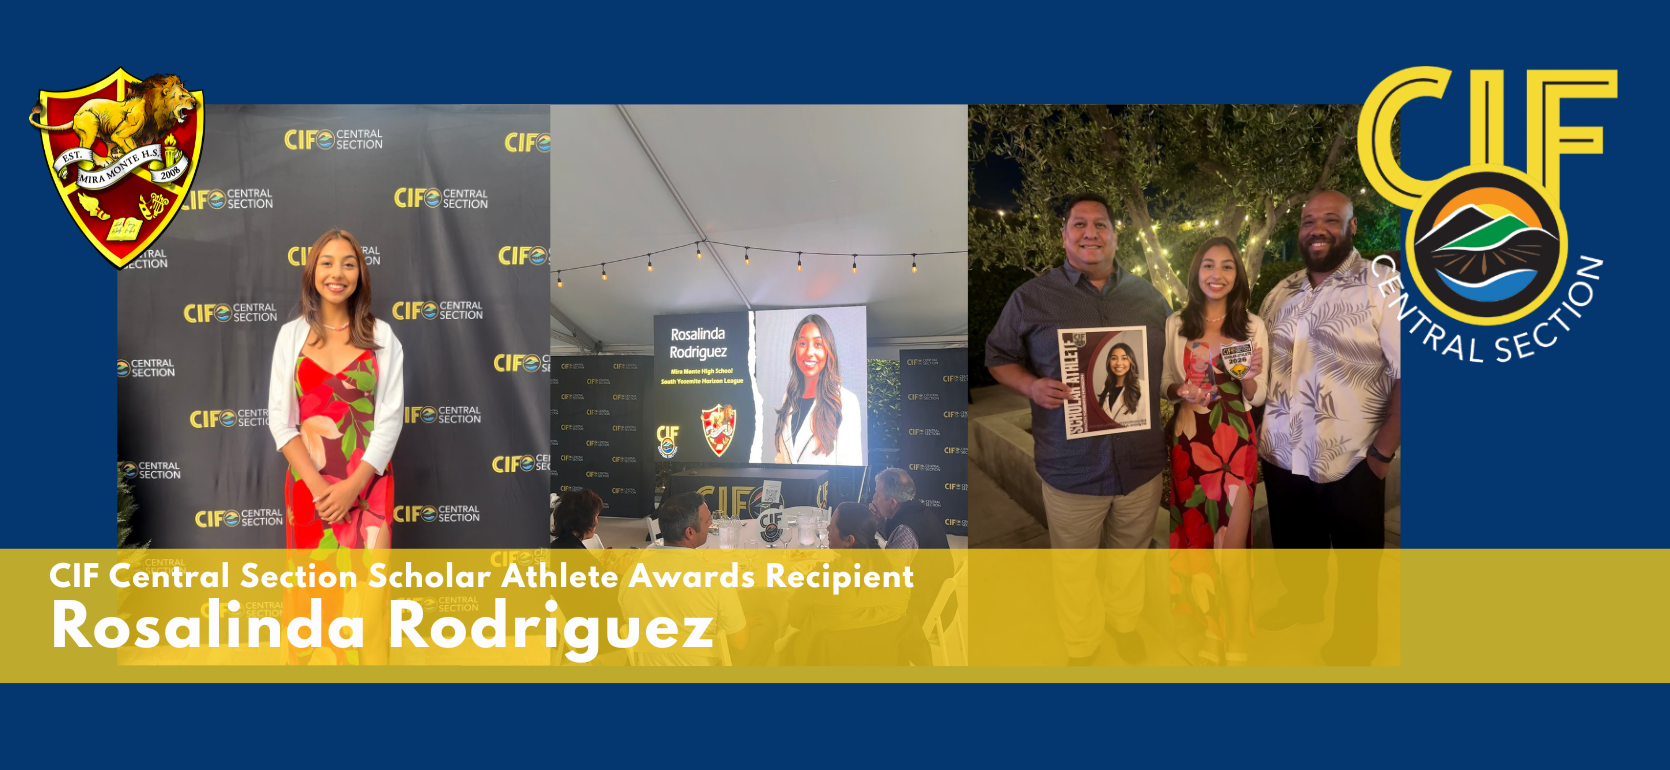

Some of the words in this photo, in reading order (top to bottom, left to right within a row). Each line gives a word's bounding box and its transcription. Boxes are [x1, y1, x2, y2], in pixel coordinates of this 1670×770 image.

[336, 128, 383, 139] CENTRAL
[284, 129, 316, 150] CIF
[336, 140, 383, 149] SECTION
[504, 132, 538, 152] CIF
[227, 188, 273, 198] CENTRAL
[394, 188, 424, 208] CIF
[443, 188, 487, 198] CENTRAL
[181, 189, 208, 210] IF
[228, 199, 274, 209] SECTION
[443, 199, 488, 208] SECTION
[498, 246, 532, 265] CIF
[232, 302, 277, 312] CENTRAL
[440, 300, 482, 310] CENTRAL
[184, 304, 213, 323] CIF
[392, 301, 422, 320] CIF
[440, 310, 483, 320] SECTION
[233, 312, 277, 322] SECTION
[671, 327, 726, 341] Rosalinda
[670, 346, 728, 362] Rodriguez
[131, 359, 174, 368] CENTRAL
[494, 354, 526, 372] CIF
[132, 368, 175, 377] SECTION
[702, 368, 714, 376] High
[238, 409, 268, 417] CENTR
[405, 407, 422, 423] IF
[438, 406, 481, 414] CENTRAL
[190, 410, 221, 428] CIF
[438, 415, 481, 424] SECTION
[656, 426, 680, 442] CIF
[138, 462, 180, 470] CENTRAL
[492, 456, 521, 474] CIF
[140, 470, 181, 479] SECTION
[241, 508, 282, 518] CENTRAL
[393, 505, 422, 522] CIF
[438, 505, 480, 514] CENTRAL
[194, 510, 225, 528] CIF
[242, 518, 283, 526] SECTION
[438, 514, 480, 522] SECTION
[760, 512, 783, 528] CIF
[439, 604, 479, 612] SECTION
